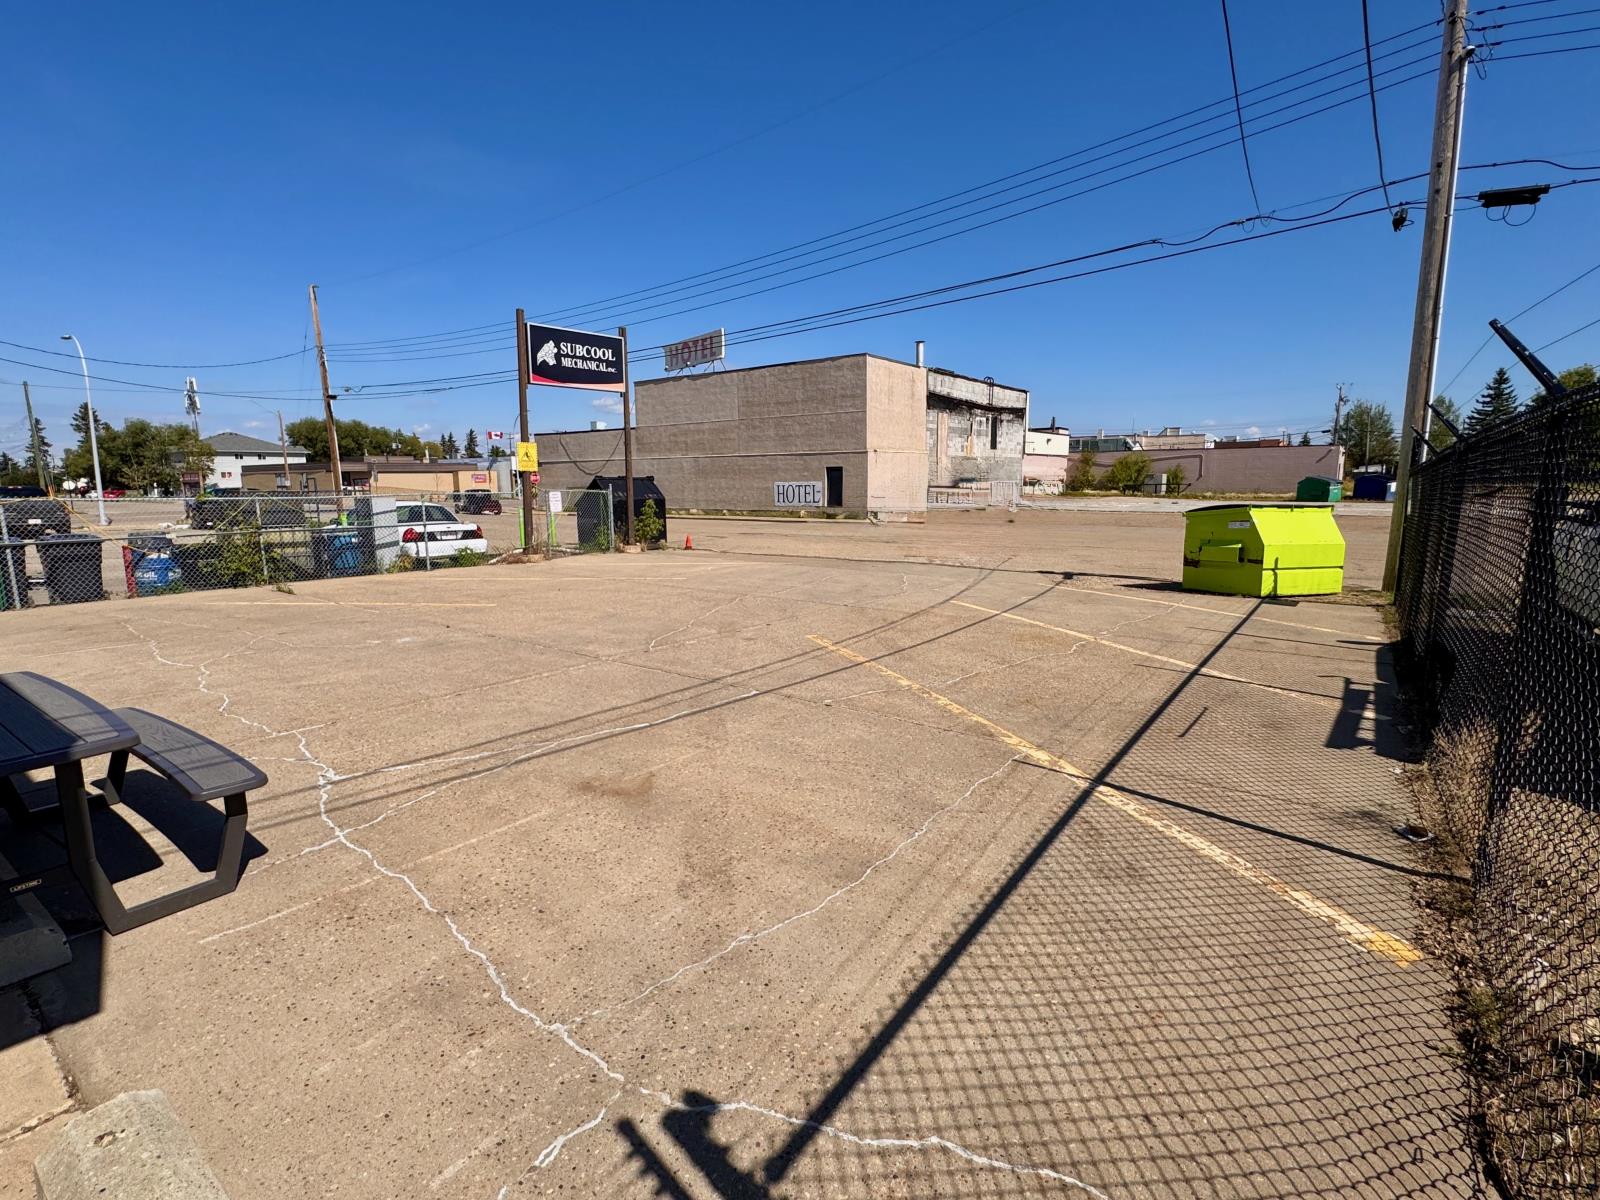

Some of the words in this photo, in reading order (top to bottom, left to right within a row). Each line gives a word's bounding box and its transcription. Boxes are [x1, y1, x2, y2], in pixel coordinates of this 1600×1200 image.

[560, 342, 616, 361] SUBCOOL
[669, 336, 717, 368] HOTEL
[561, 357, 608, 373] MECHANICAL
